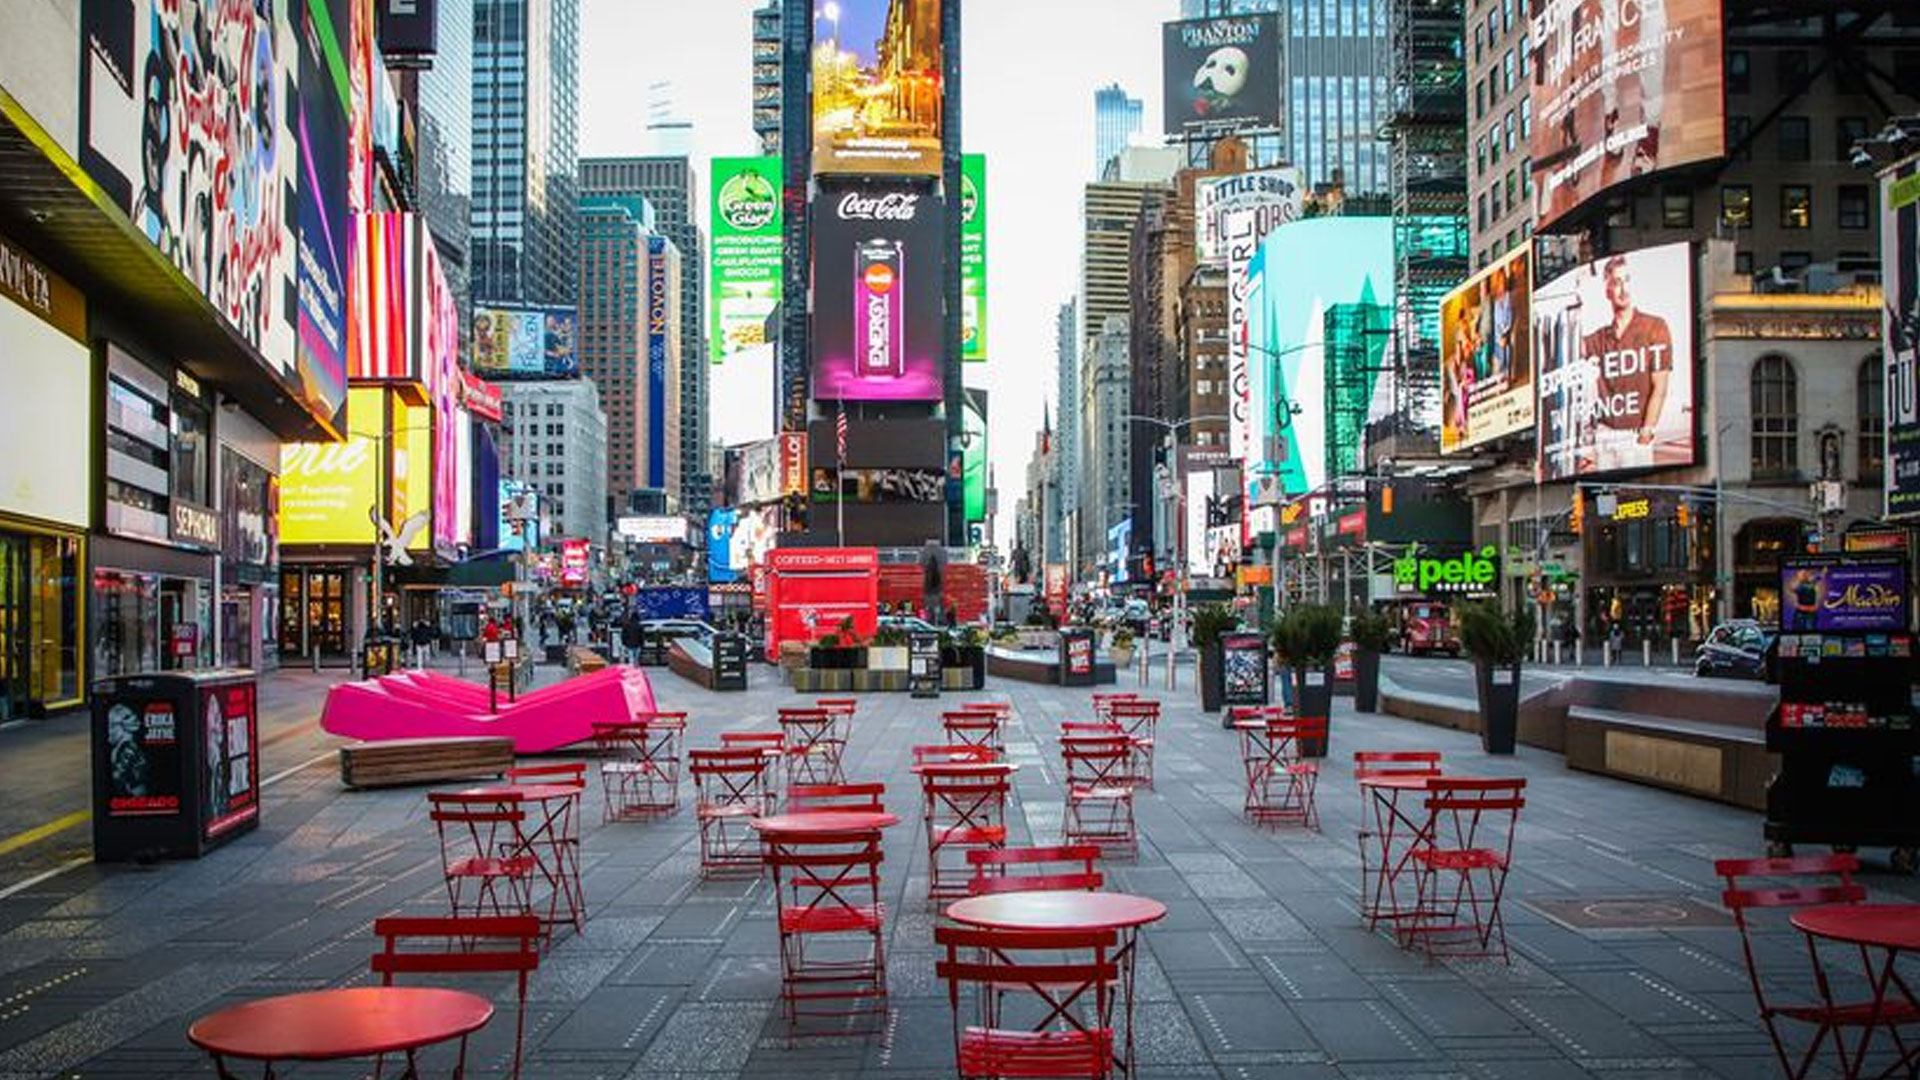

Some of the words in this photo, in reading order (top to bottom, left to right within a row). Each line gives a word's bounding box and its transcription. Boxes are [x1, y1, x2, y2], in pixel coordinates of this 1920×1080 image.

[1181, 23, 1260, 43] PHANTOM
[1206, 176, 1255, 206] LITTLE
[1258, 176, 1294, 198] SHOP
[1206, 202, 1296, 254] HOORS
[868, 293, 889, 366] ENERGY
[1604, 343, 1668, 378] EDIT
[176, 505, 217, 543] SEPHORA
[1419, 545, 1496, 590] pelé
